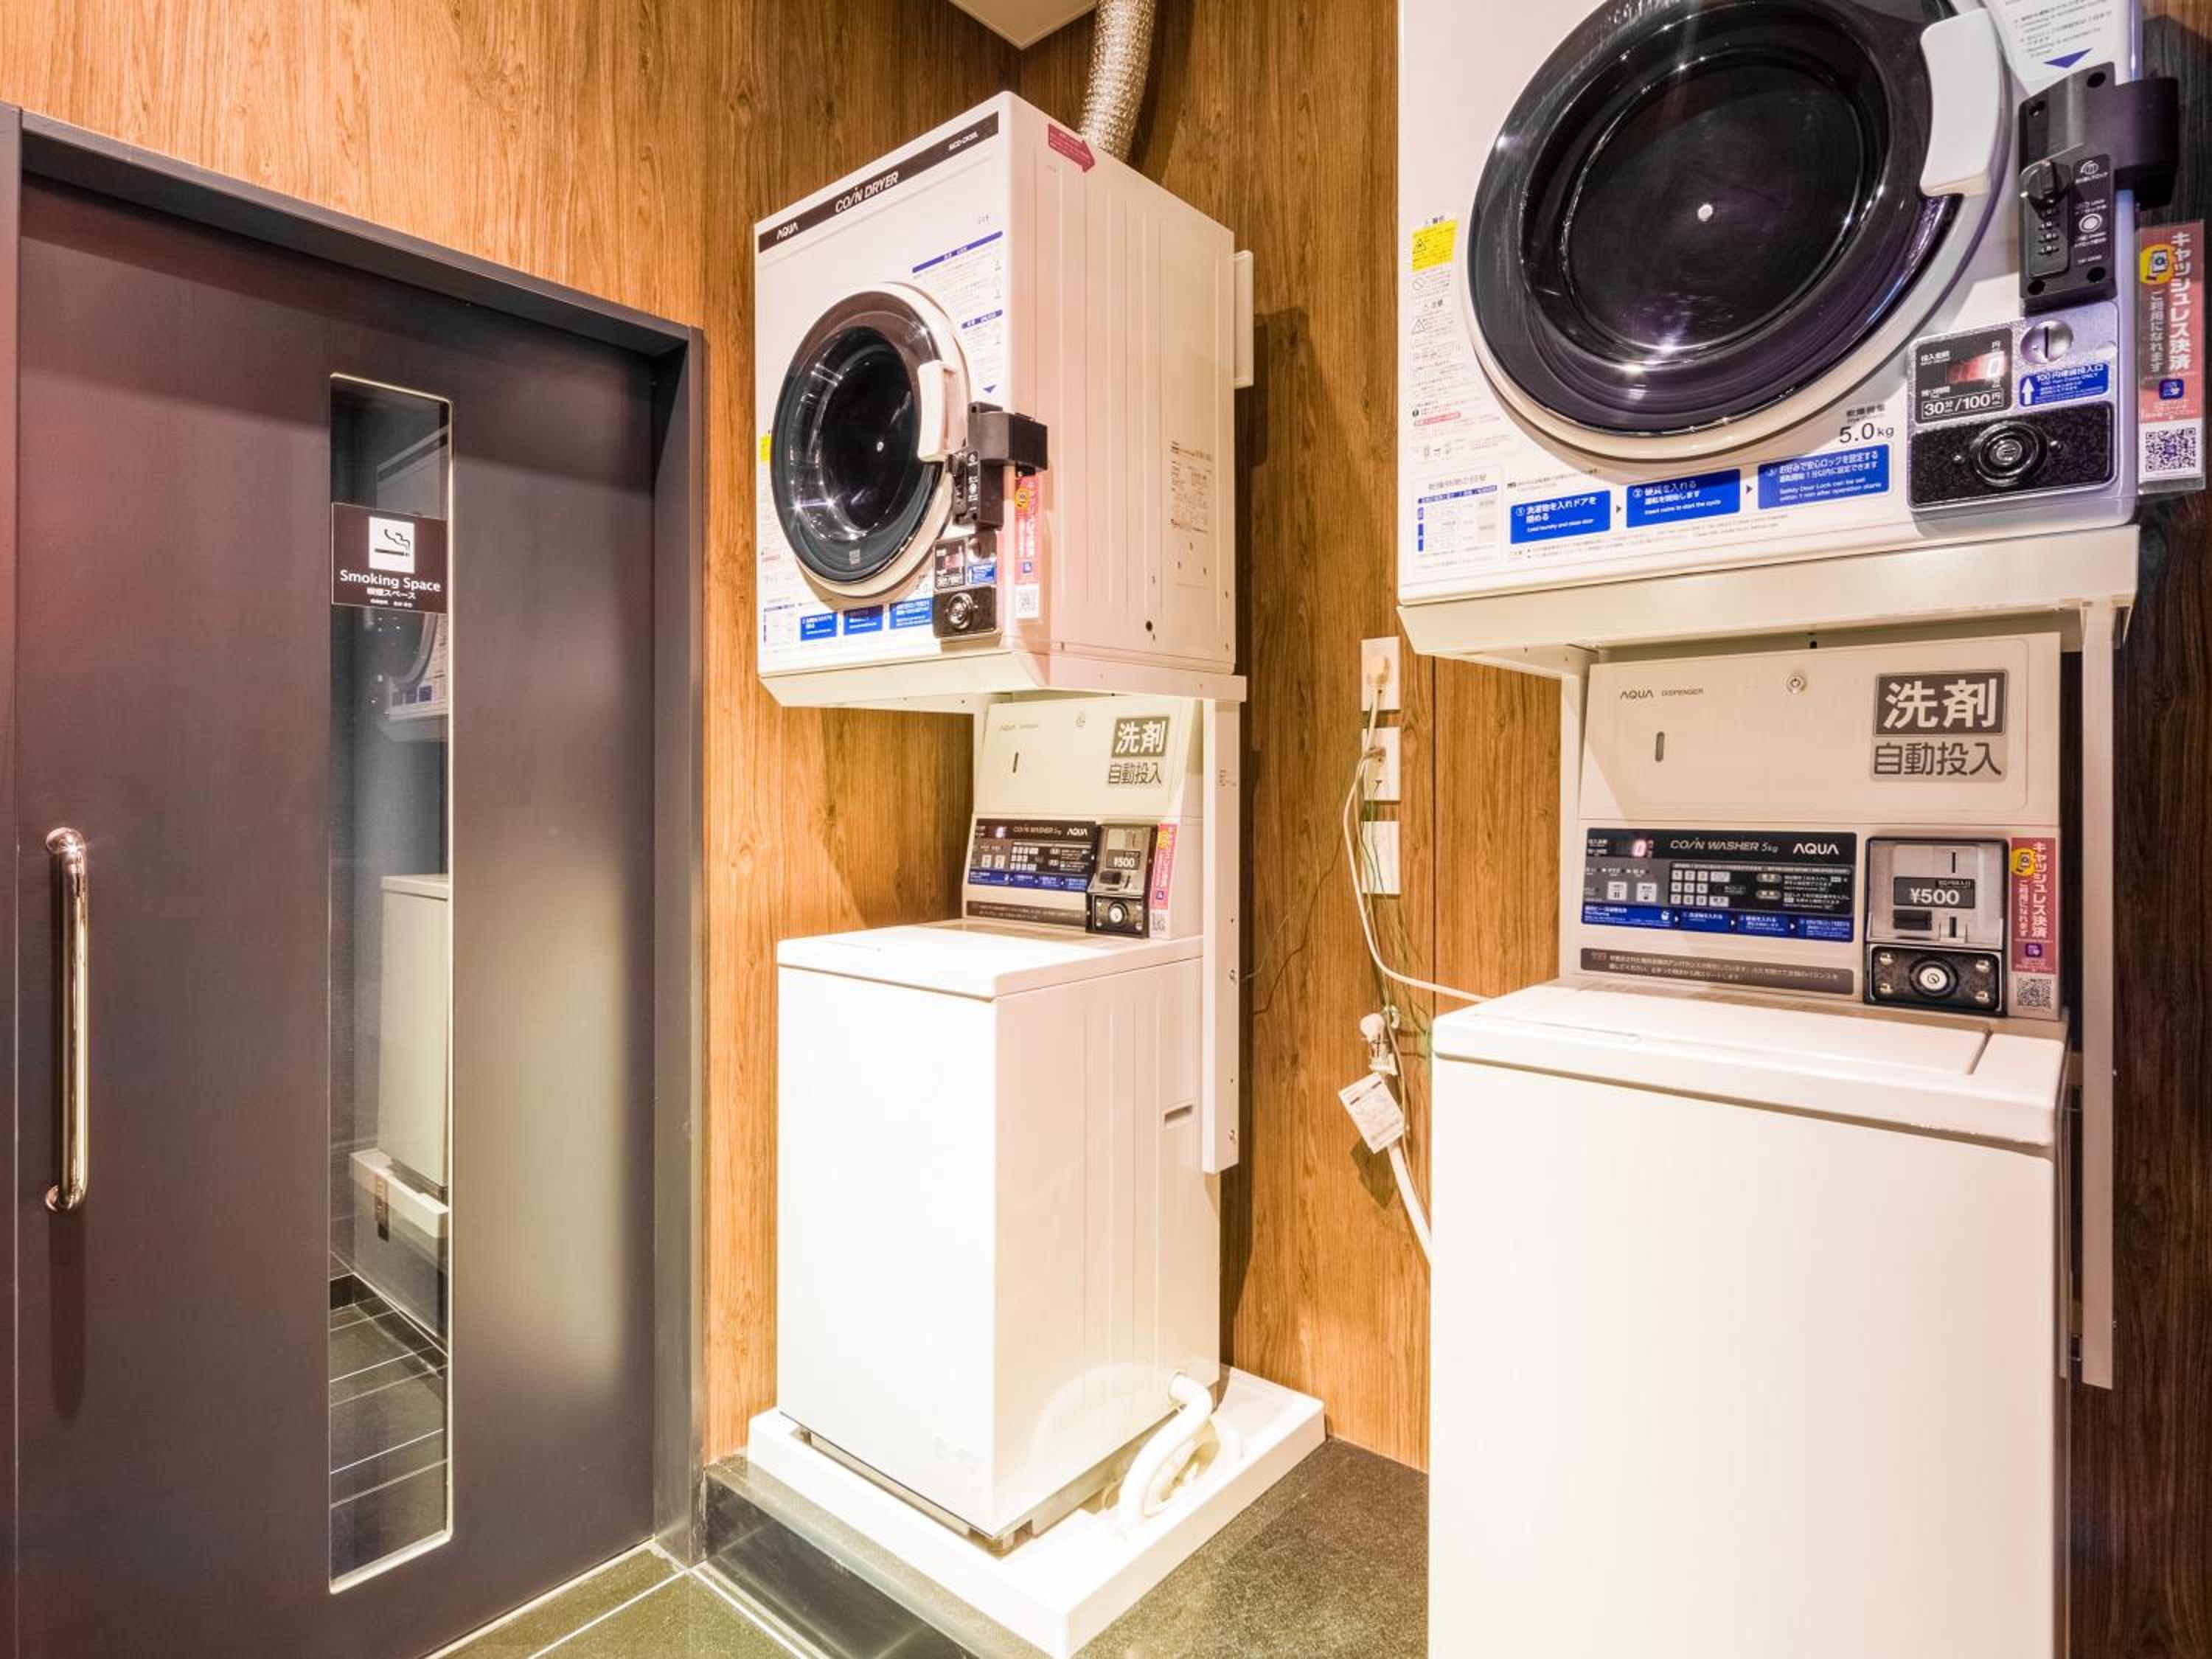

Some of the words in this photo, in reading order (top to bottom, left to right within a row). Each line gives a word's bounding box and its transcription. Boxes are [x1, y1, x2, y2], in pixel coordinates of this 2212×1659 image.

[864, 171, 899, 198] DRYER
[776, 222, 799, 240] AQUA
[2170, 232, 2191, 370] キャッシュレス決済
[340, 568, 399, 589] Smoking
[403, 577, 441, 592] Space
[1620, 689, 1655, 700] AQUA
[1883, 678, 1997, 729] 洗剤
[1114, 720, 1166, 754] 洗剤
[1874, 741, 2003, 776] 自動投入
[1108, 762, 1162, 785] 自動投入
[1067, 827, 1088, 836] AQUA
[1708, 840, 1759, 852] WASHER
[1792, 843, 1840, 855] AQUA
[1113, 857, 1135, 868] ¥500
[1910, 888, 1960, 905] ¥500
[2031, 841, 2048, 939] キャッシュレス決済
